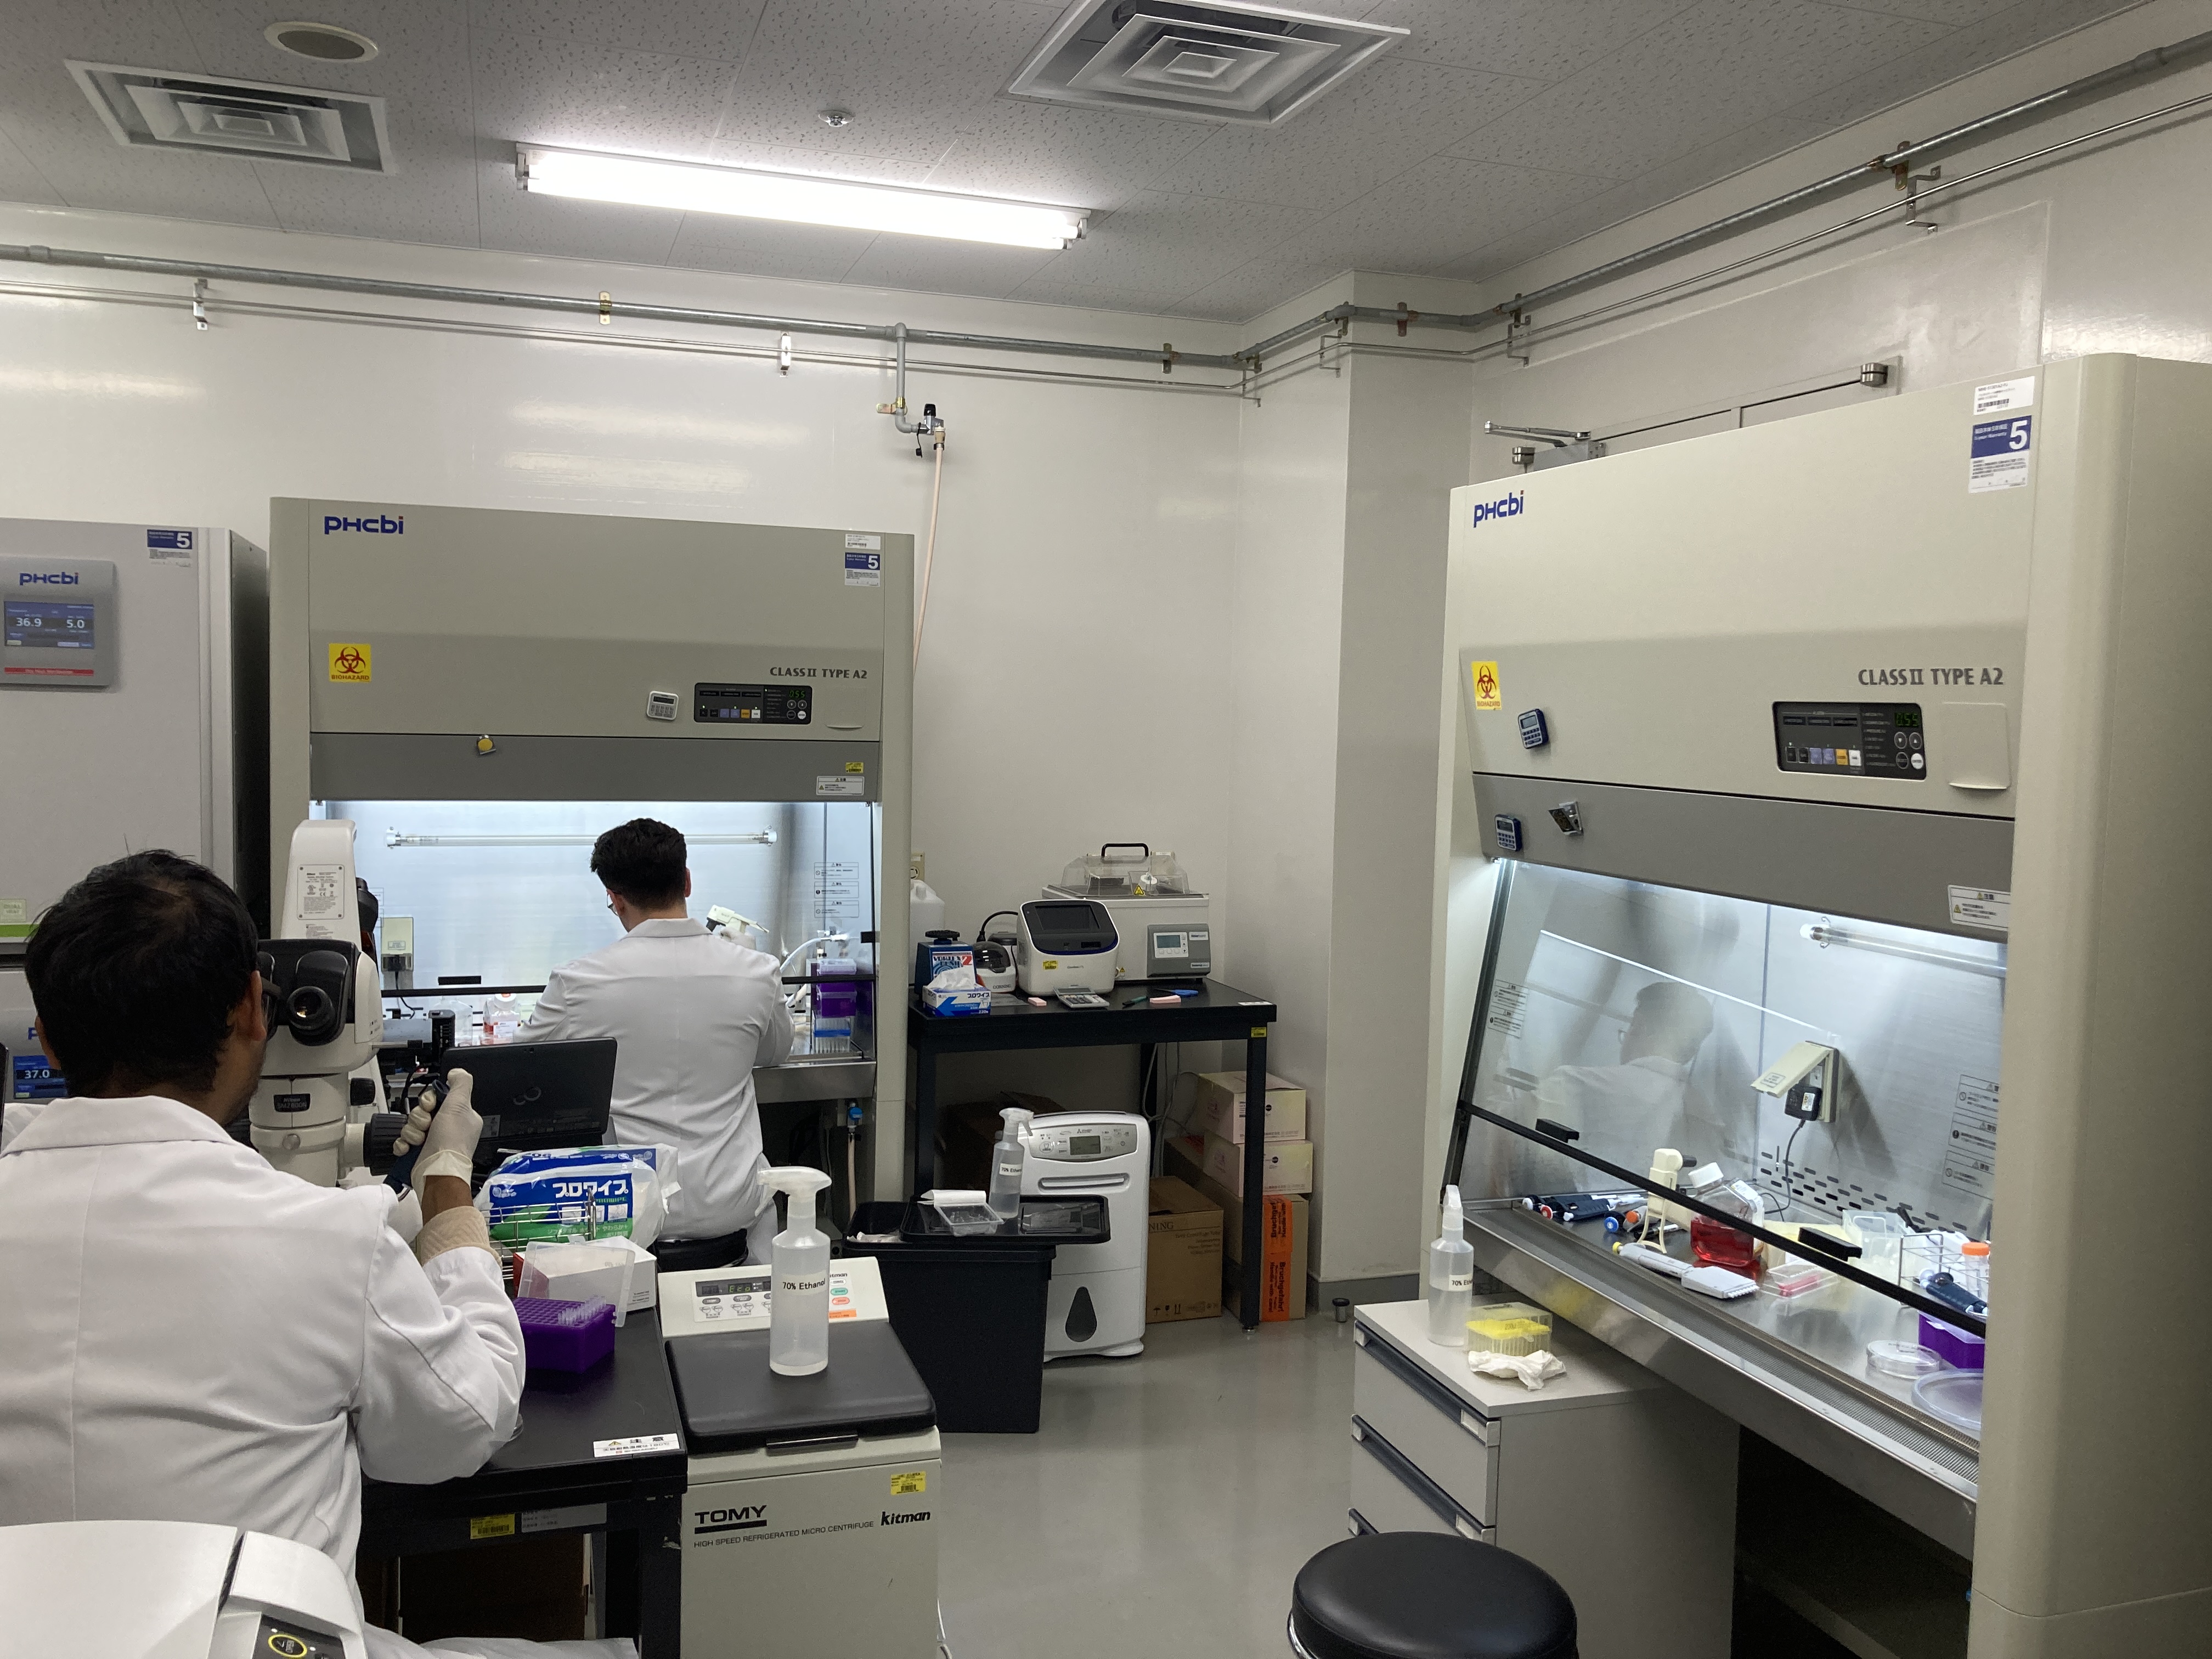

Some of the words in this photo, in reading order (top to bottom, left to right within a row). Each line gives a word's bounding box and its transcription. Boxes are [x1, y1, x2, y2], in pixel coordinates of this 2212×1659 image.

[2008, 420, 2028, 450] 5
[177, 532, 190, 548] 5
[867, 555, 879, 569] 5
[16, 617, 42, 628] 36.9
[66, 619, 86, 629] 5.0
[822, 669, 850, 678] TYPE
[853, 670, 868, 679] A2
[1930, 668, 1975, 685] TYPE
[1980, 667, 2004, 685] A2
[1476, 699, 1501, 708] BIOHAZARD
[962, 956, 973, 966] 2
[25, 1069, 50, 1079] 37.0
[552, 1179, 629, 1199] プロワイプ
[1148, 1221, 1175, 1231] NING
[782, 1282, 796, 1290] 70%
[799, 1278, 826, 1290] Ethanol
[694, 1505, 767, 1525] TOMY
[880, 1510, 931, 1526] kitman
[693, 1540, 714, 1548] HIGH
[715, 1537, 741, 1546] SPEED
[743, 1530, 800, 1543] REFRIGERATED
[801, 1526, 826, 1536] MICRO
[828, 1521, 874, 1533] CENTRIFUGE
